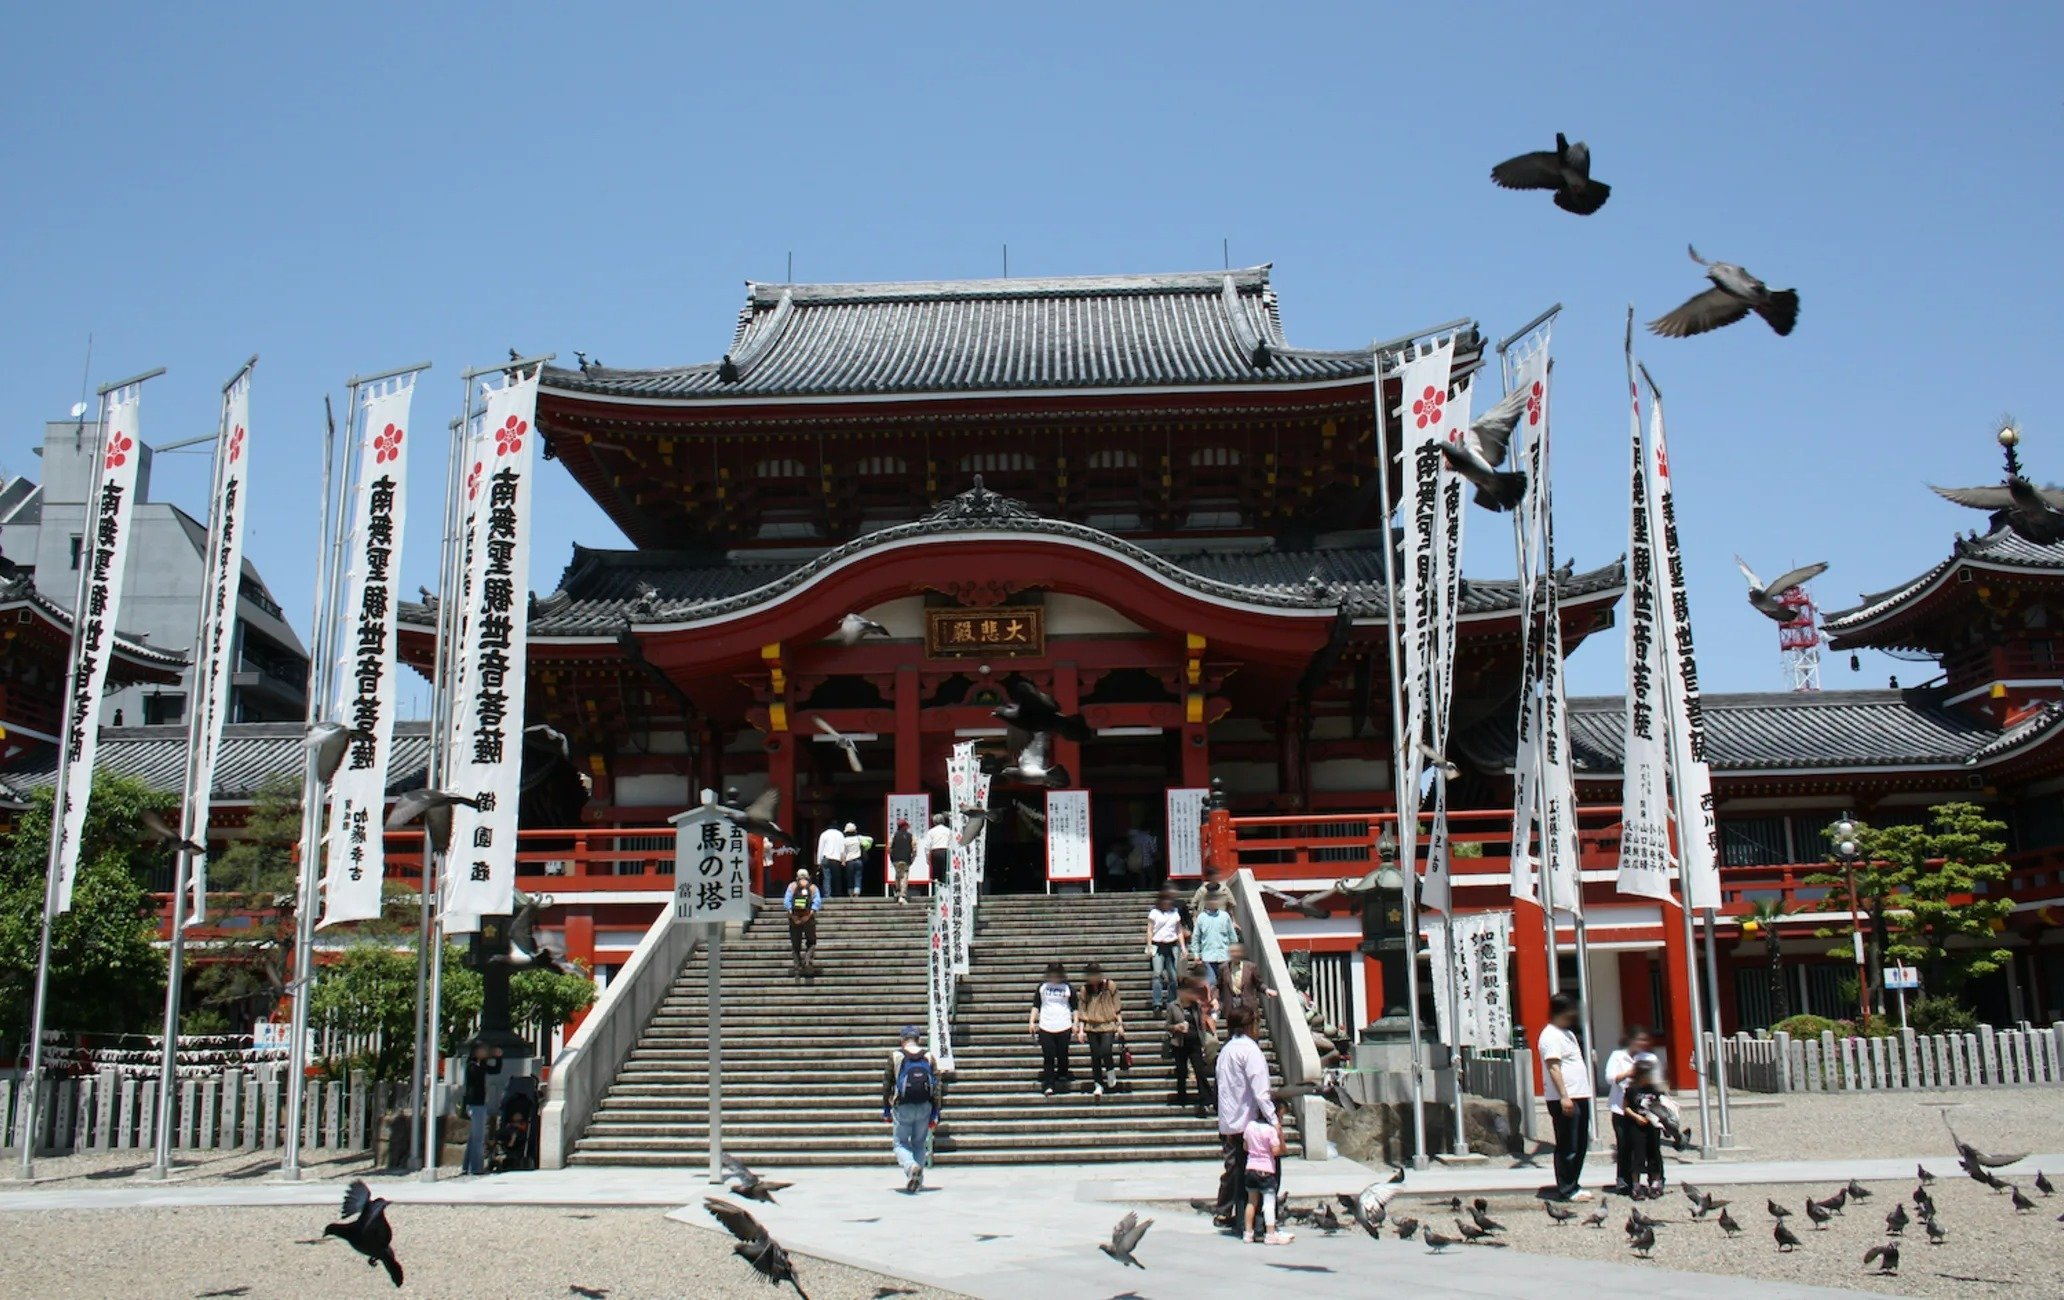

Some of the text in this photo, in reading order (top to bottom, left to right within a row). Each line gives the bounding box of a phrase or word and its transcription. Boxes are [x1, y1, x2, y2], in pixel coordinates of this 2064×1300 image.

[949, 619, 1027, 642] 大悲殿
[696, 822, 727, 911] 馬の塔
[730, 825, 743, 899] 五月十八日
[1480, 930, 1500, 1006] 如意輪観音
